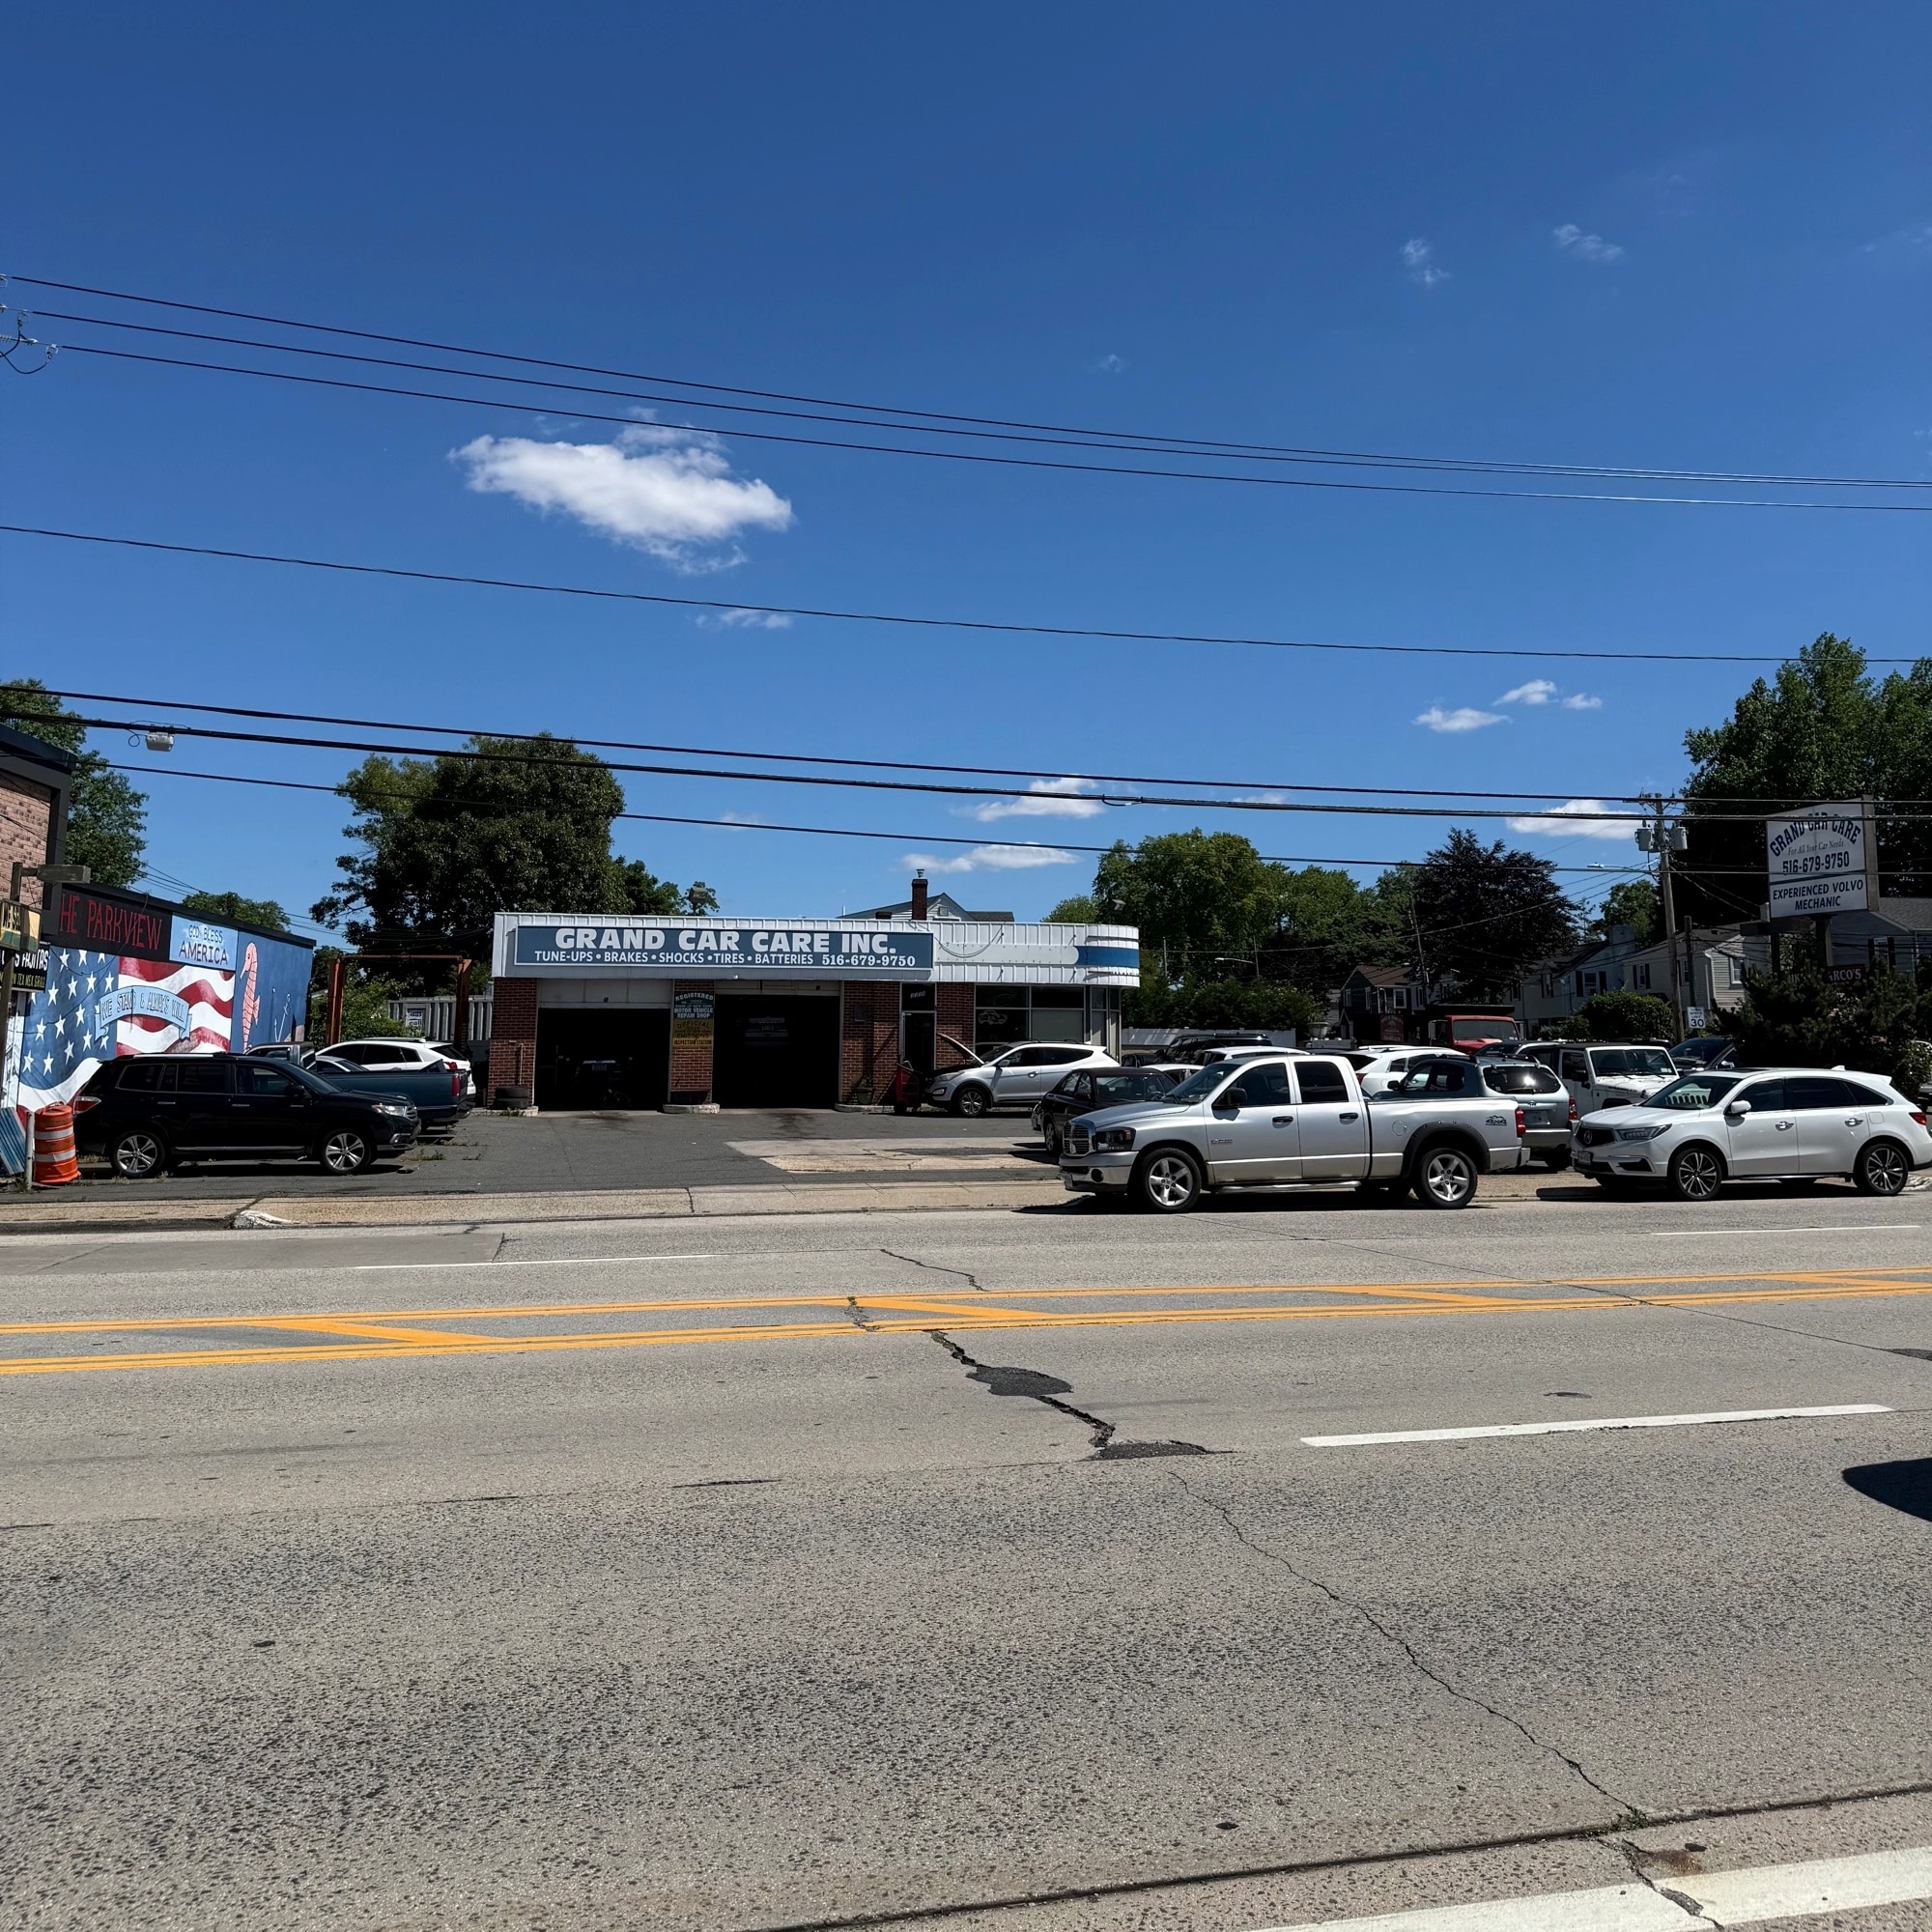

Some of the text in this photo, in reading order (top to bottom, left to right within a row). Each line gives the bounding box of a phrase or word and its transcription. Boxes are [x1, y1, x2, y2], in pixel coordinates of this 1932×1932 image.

[1770, 812, 1861, 857] GRAND CAR CARE
[1818, 841, 1828, 850] Car
[1782, 850, 1850, 875] 516-679-9750
[1773, 879, 1863, 900] EXPERIENCED VOLVO
[1795, 895, 1841, 910] MECHANIC
[86, 899, 162, 951] PARKVIEW
[188, 924, 223, 944] GOD BLESS
[554, 927, 896, 954] GRAND CAR CARE INC.
[179, 941, 228, 965] AMERICA
[534, 951, 916, 967] TUNE-UPS BRAKES SHOCKS TIRES BATTERIES 516-679-9750
[1690, 1018, 1704, 1027] 30
